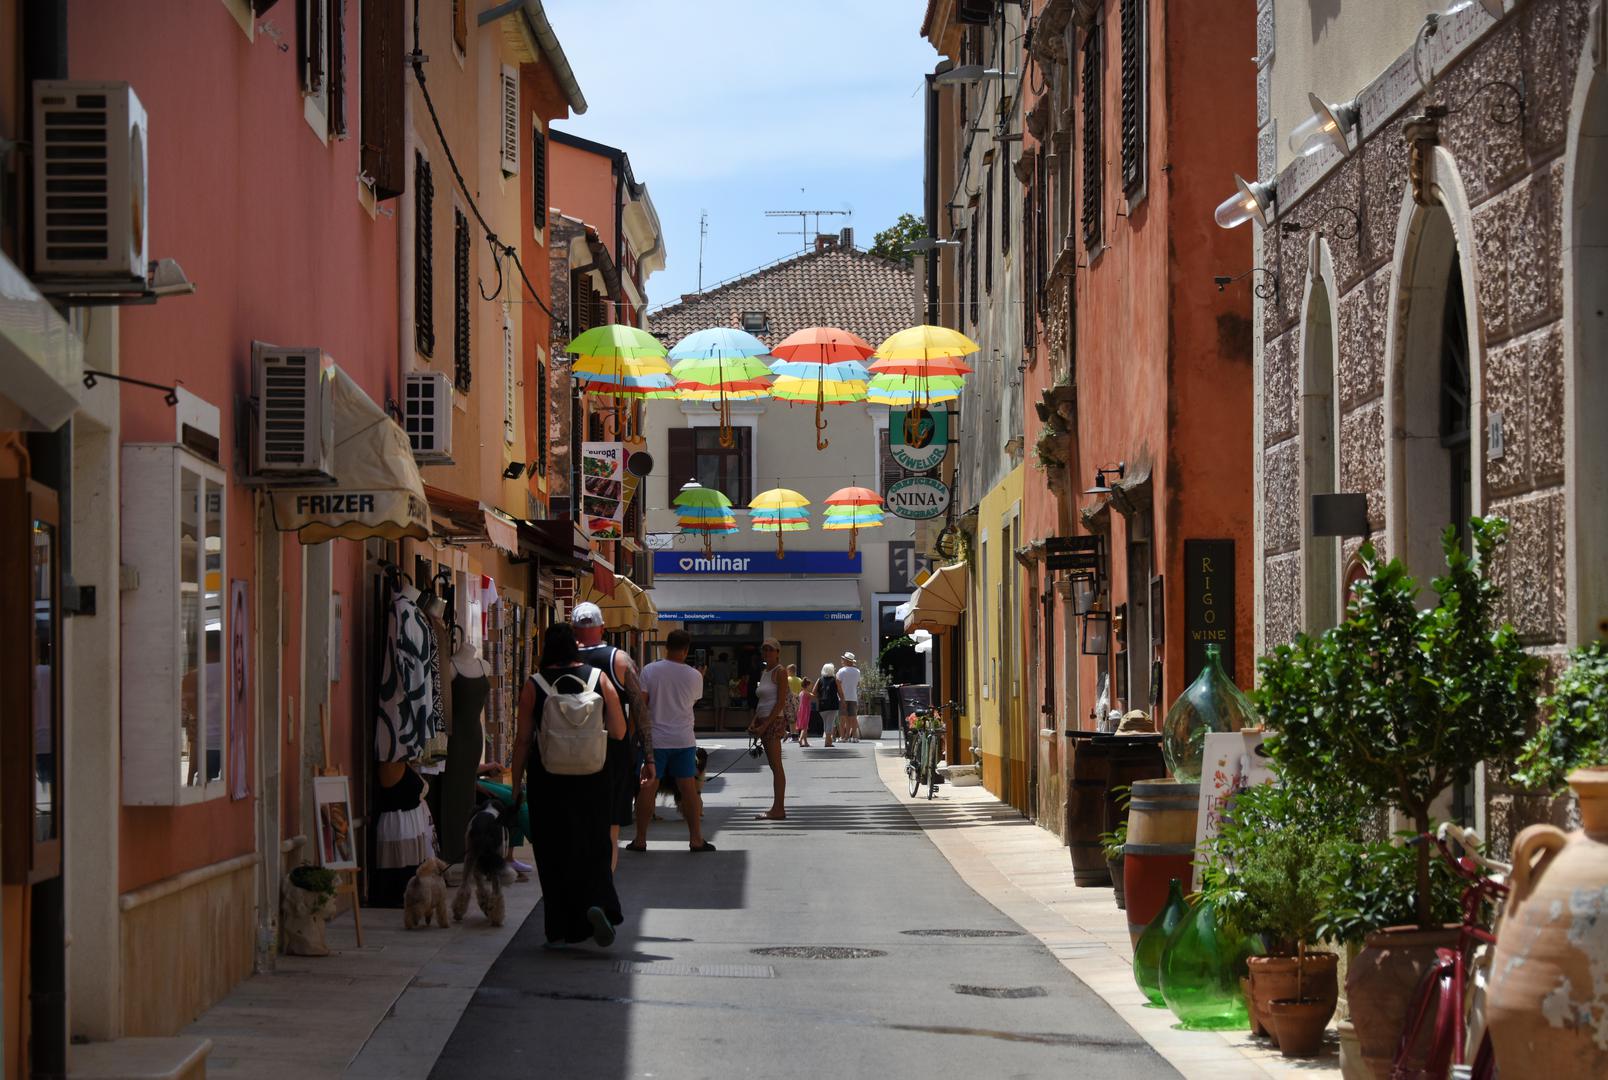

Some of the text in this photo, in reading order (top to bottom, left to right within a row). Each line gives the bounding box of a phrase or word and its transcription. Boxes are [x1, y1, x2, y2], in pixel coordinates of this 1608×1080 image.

[893, 448, 945, 470] JUWELIER
[296, 494, 375, 515] FRIZER
[895, 493, 938, 506] NINA
[694, 554, 751, 571] mlinar
[1201, 557, 1216, 624] RIGO
[830, 612, 853, 620] mlinar
[1192, 630, 1226, 640] WINE
